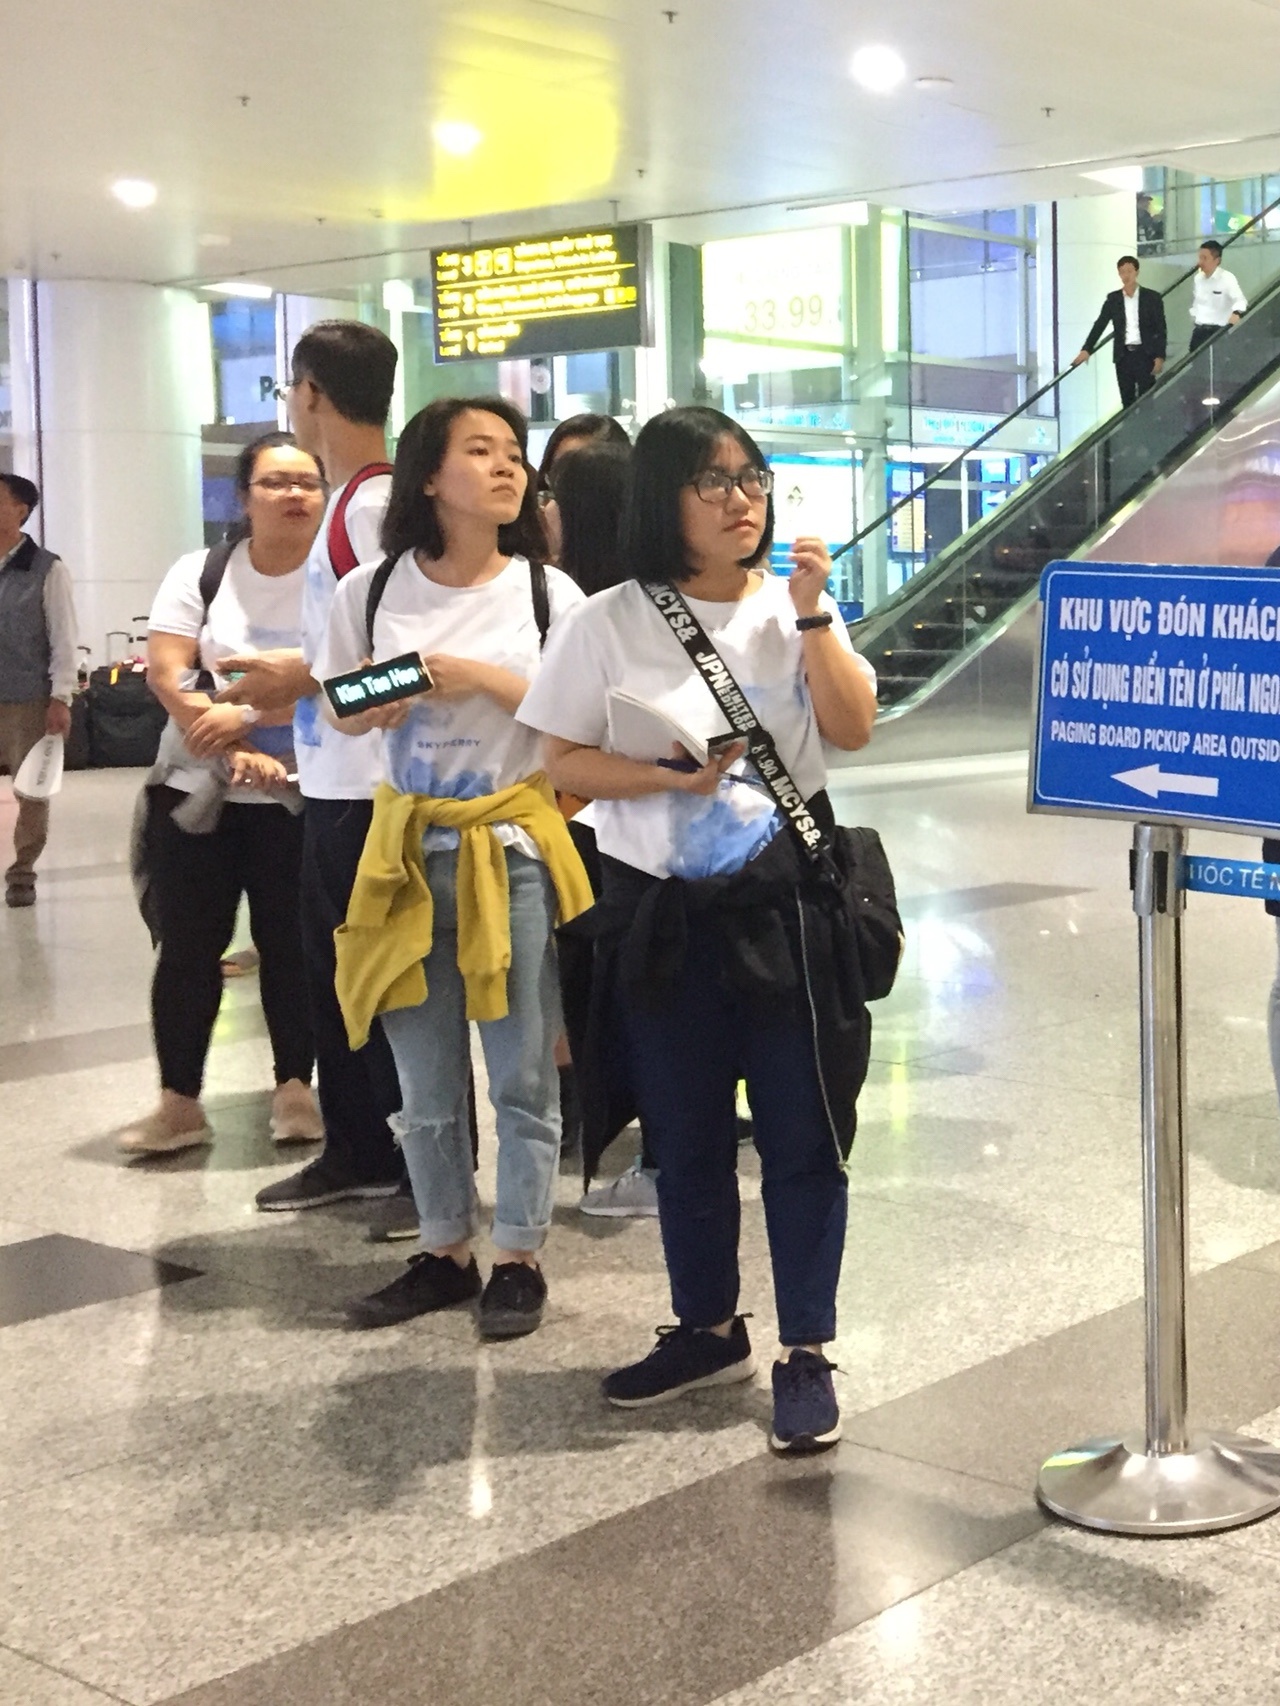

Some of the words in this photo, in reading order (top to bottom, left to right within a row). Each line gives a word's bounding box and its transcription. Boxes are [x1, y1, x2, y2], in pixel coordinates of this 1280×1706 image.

[1060, 597, 1102, 631] KHU
[1109, 597, 1151, 640] VỰC
[1158, 595, 1205, 637] ĐÓN
[1051, 653, 1068, 698] CÓ
[1072, 646, 1091, 699] SỬ
[1092, 662, 1130, 709] DỤNG
[1132, 651, 1165, 705] BIỂN
[1169, 660, 1195, 708] TÊN
[1199, 653, 1210, 709] Ở
[1211, 664, 1244, 711] PHÍA
[726, 683, 756, 728] LIMITED
[1051, 721, 1095, 745] PAGING
[1099, 725, 1141, 748] BOARD
[1144, 730, 1190, 753] PICKUP
[1193, 735, 1227, 757] AREA
